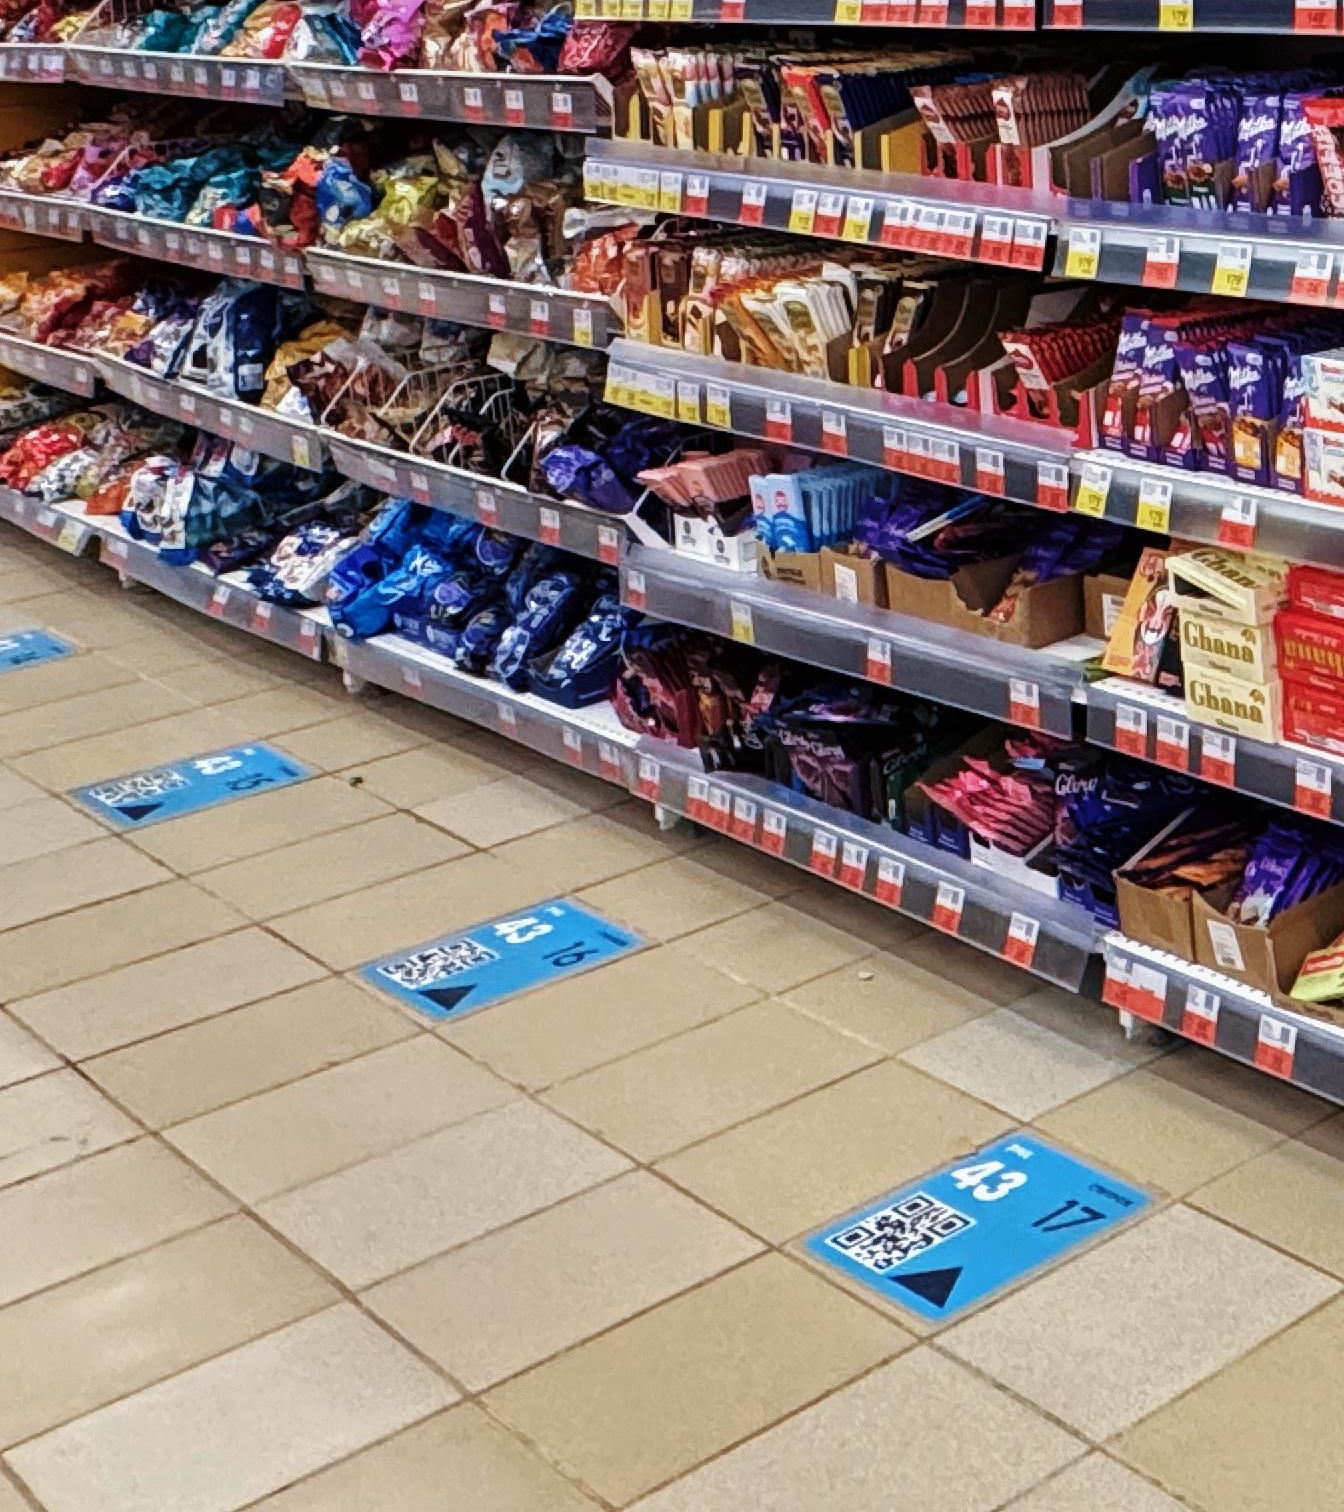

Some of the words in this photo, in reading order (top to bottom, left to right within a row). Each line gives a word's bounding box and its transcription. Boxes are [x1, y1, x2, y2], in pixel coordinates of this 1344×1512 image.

[1184, 620, 1255, 664] Ghana
[1189, 678, 1264, 724] Ghana
[494, 917, 553, 944] 43
[951, 1161, 1027, 1201] 43
[1032, 1199, 1107, 1232] 17
